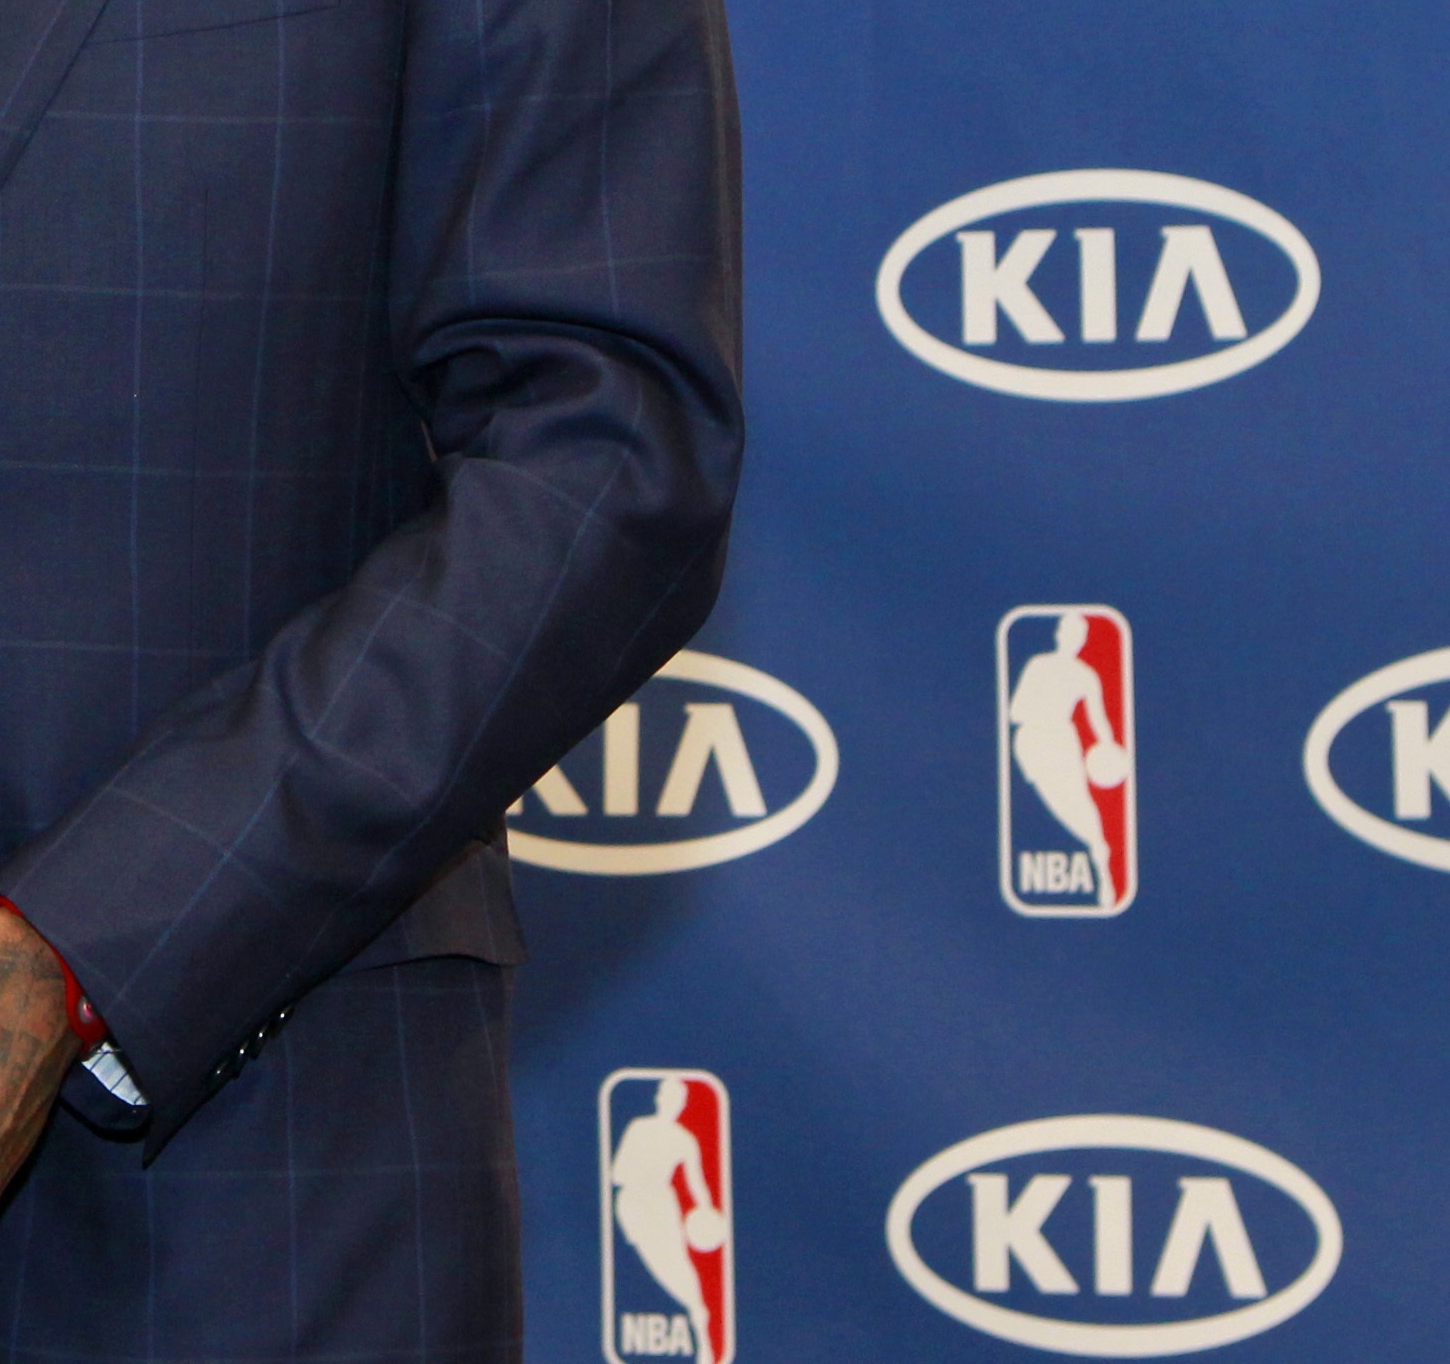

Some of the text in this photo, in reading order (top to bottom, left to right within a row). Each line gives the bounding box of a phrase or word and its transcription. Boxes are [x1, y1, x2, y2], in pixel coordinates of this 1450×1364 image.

[956, 225, 1247, 345] KIA
[1019, 852, 1094, 893] NBA
[966, 1173, 1268, 1300] KIA
[621, 1314, 694, 1356] NBA
